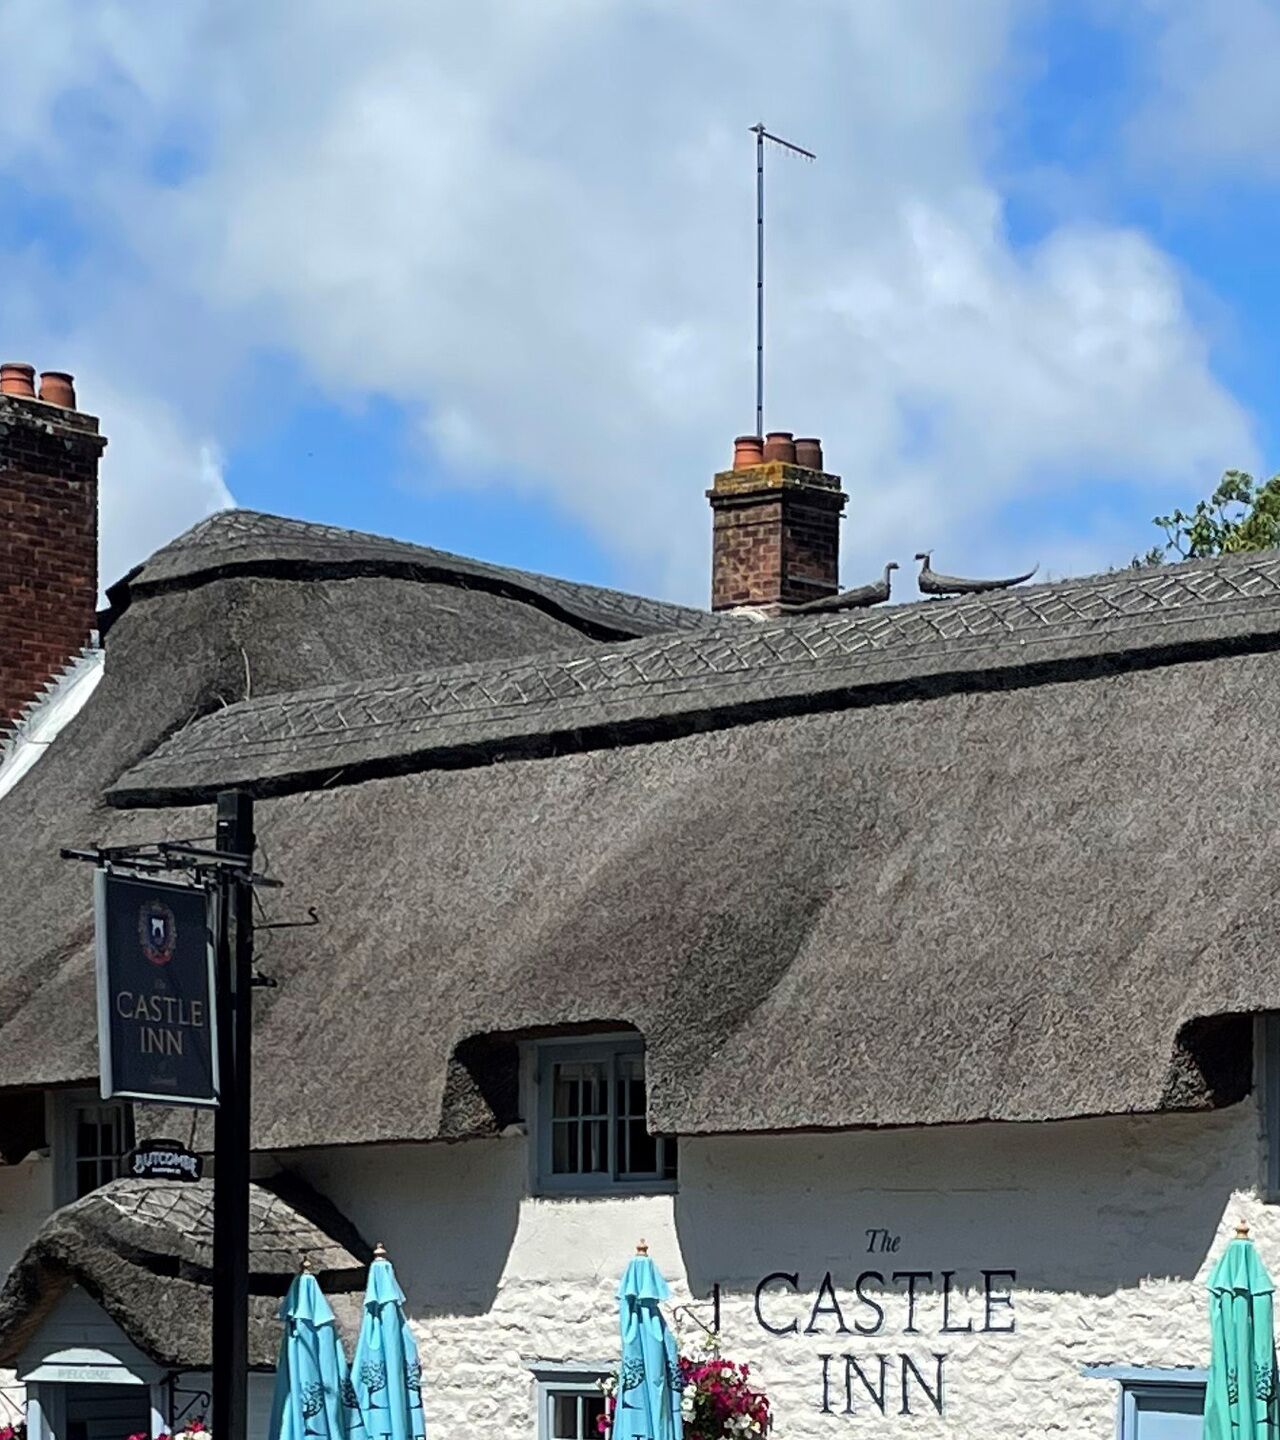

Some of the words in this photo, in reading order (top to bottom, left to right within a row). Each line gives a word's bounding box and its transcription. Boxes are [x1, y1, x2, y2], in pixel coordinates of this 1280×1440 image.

[116, 991, 204, 1027] CASTLE
[140, 1026, 184, 1056] INN
[132, 1151, 199, 1178] BUTCOMBE
[864, 1228, 902, 1253] The
[754, 1269, 1017, 1336] CASTLE
[819, 1353, 949, 1417] INN
